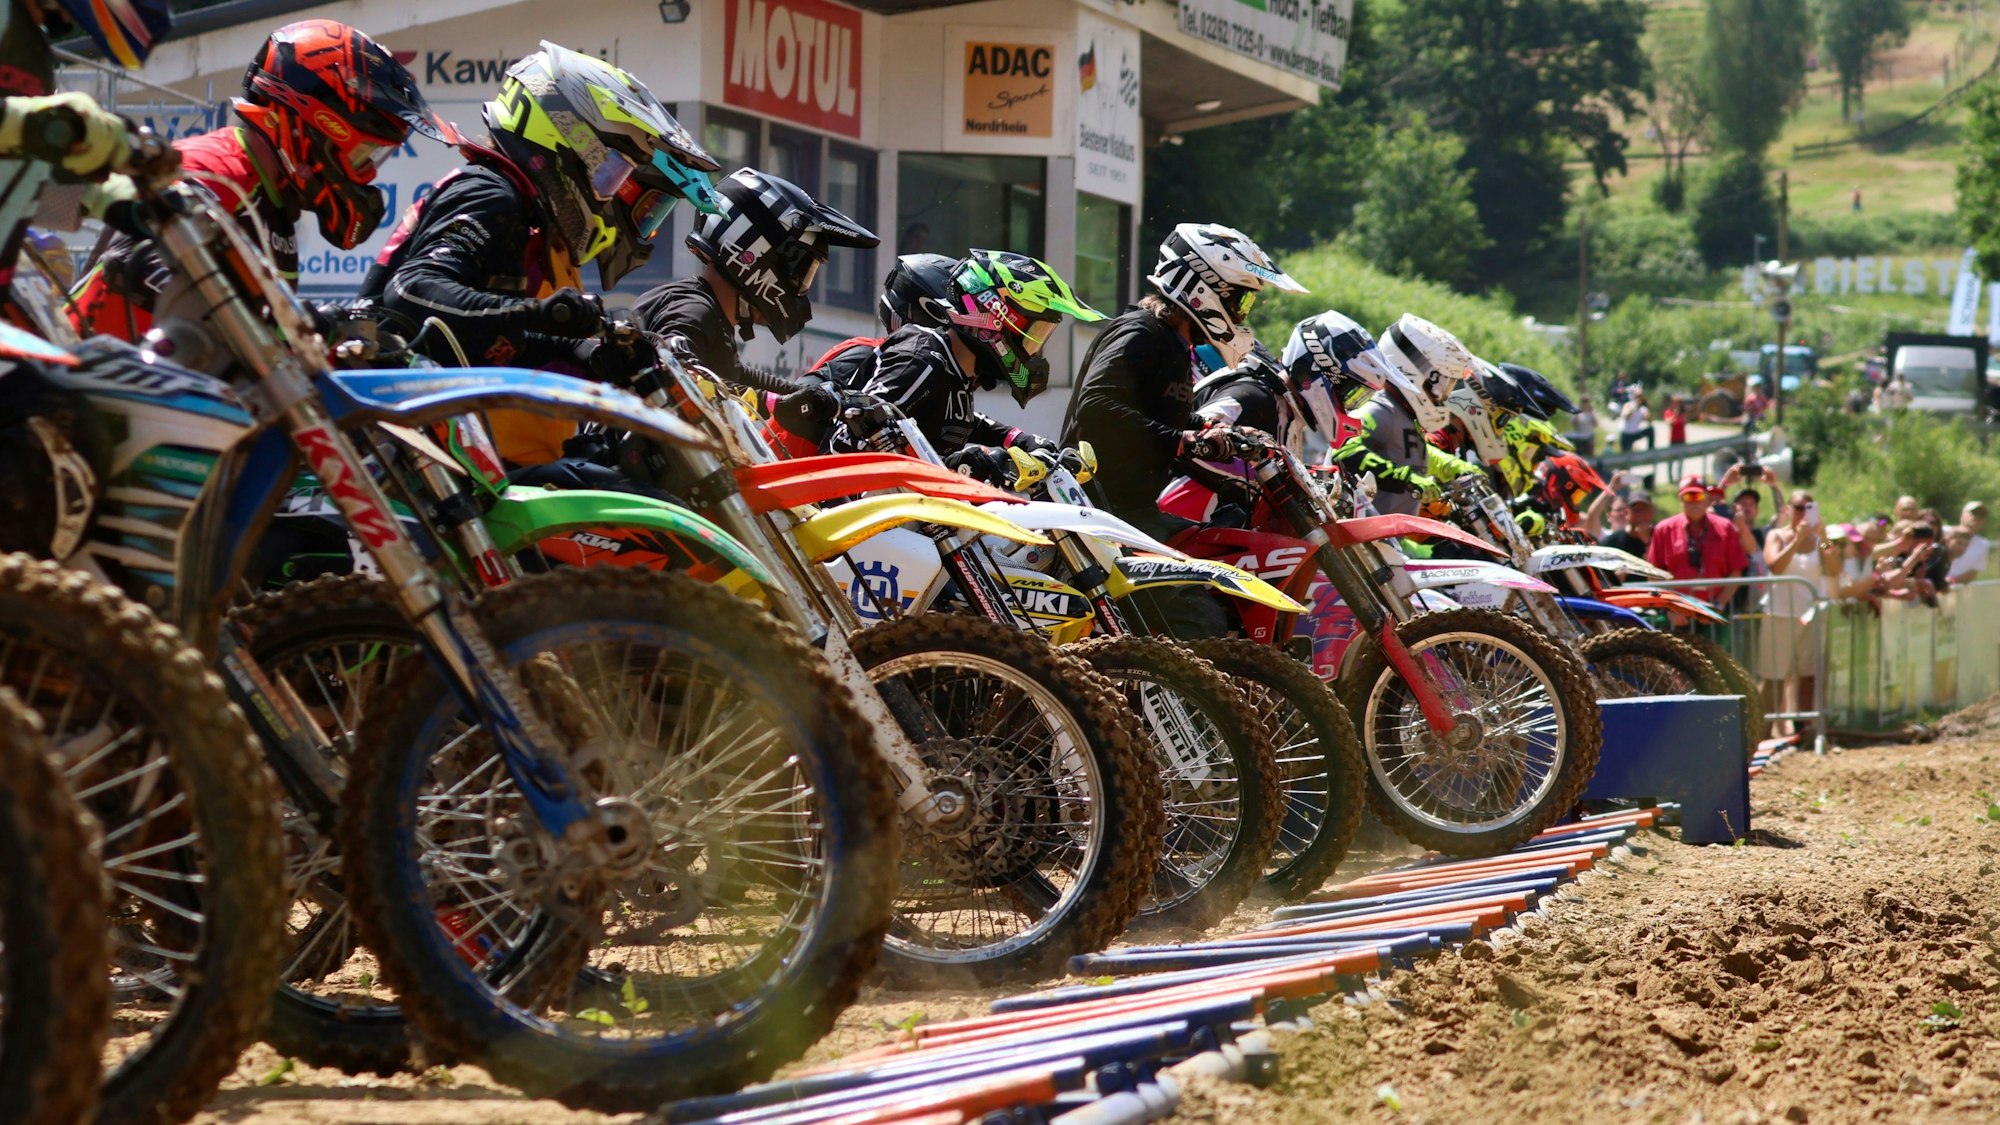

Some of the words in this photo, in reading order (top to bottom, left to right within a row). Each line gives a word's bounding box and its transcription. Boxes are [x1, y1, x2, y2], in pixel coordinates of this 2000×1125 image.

[1182, 5, 1199, 33] Tel.
[1200, 12, 1229, 44] 02262
[1232, 24, 1264, 57] 7225-0
[730, 0, 856, 117] MOTUL
[968, 45, 1050, 78] ADAC
[987, 83, 1050, 109] Sport
[315, 112, 349, 138] FMF
[965, 118, 1028, 132] Nordrhein
[818, 221, 860, 239] FASTHOUSE
[1182, 250, 1232, 299] 100%
[1814, 256, 1960, 296] BIELST
[571, 532, 622, 553] KTM
[1127, 558, 1161, 579] Troy
[1420, 568, 1480, 580] BACKYARD
[1011, 579, 1064, 591] RM-Z
[1126, 668, 1153, 677] EXCEL
[1145, 684, 1199, 764] PIRELLI
